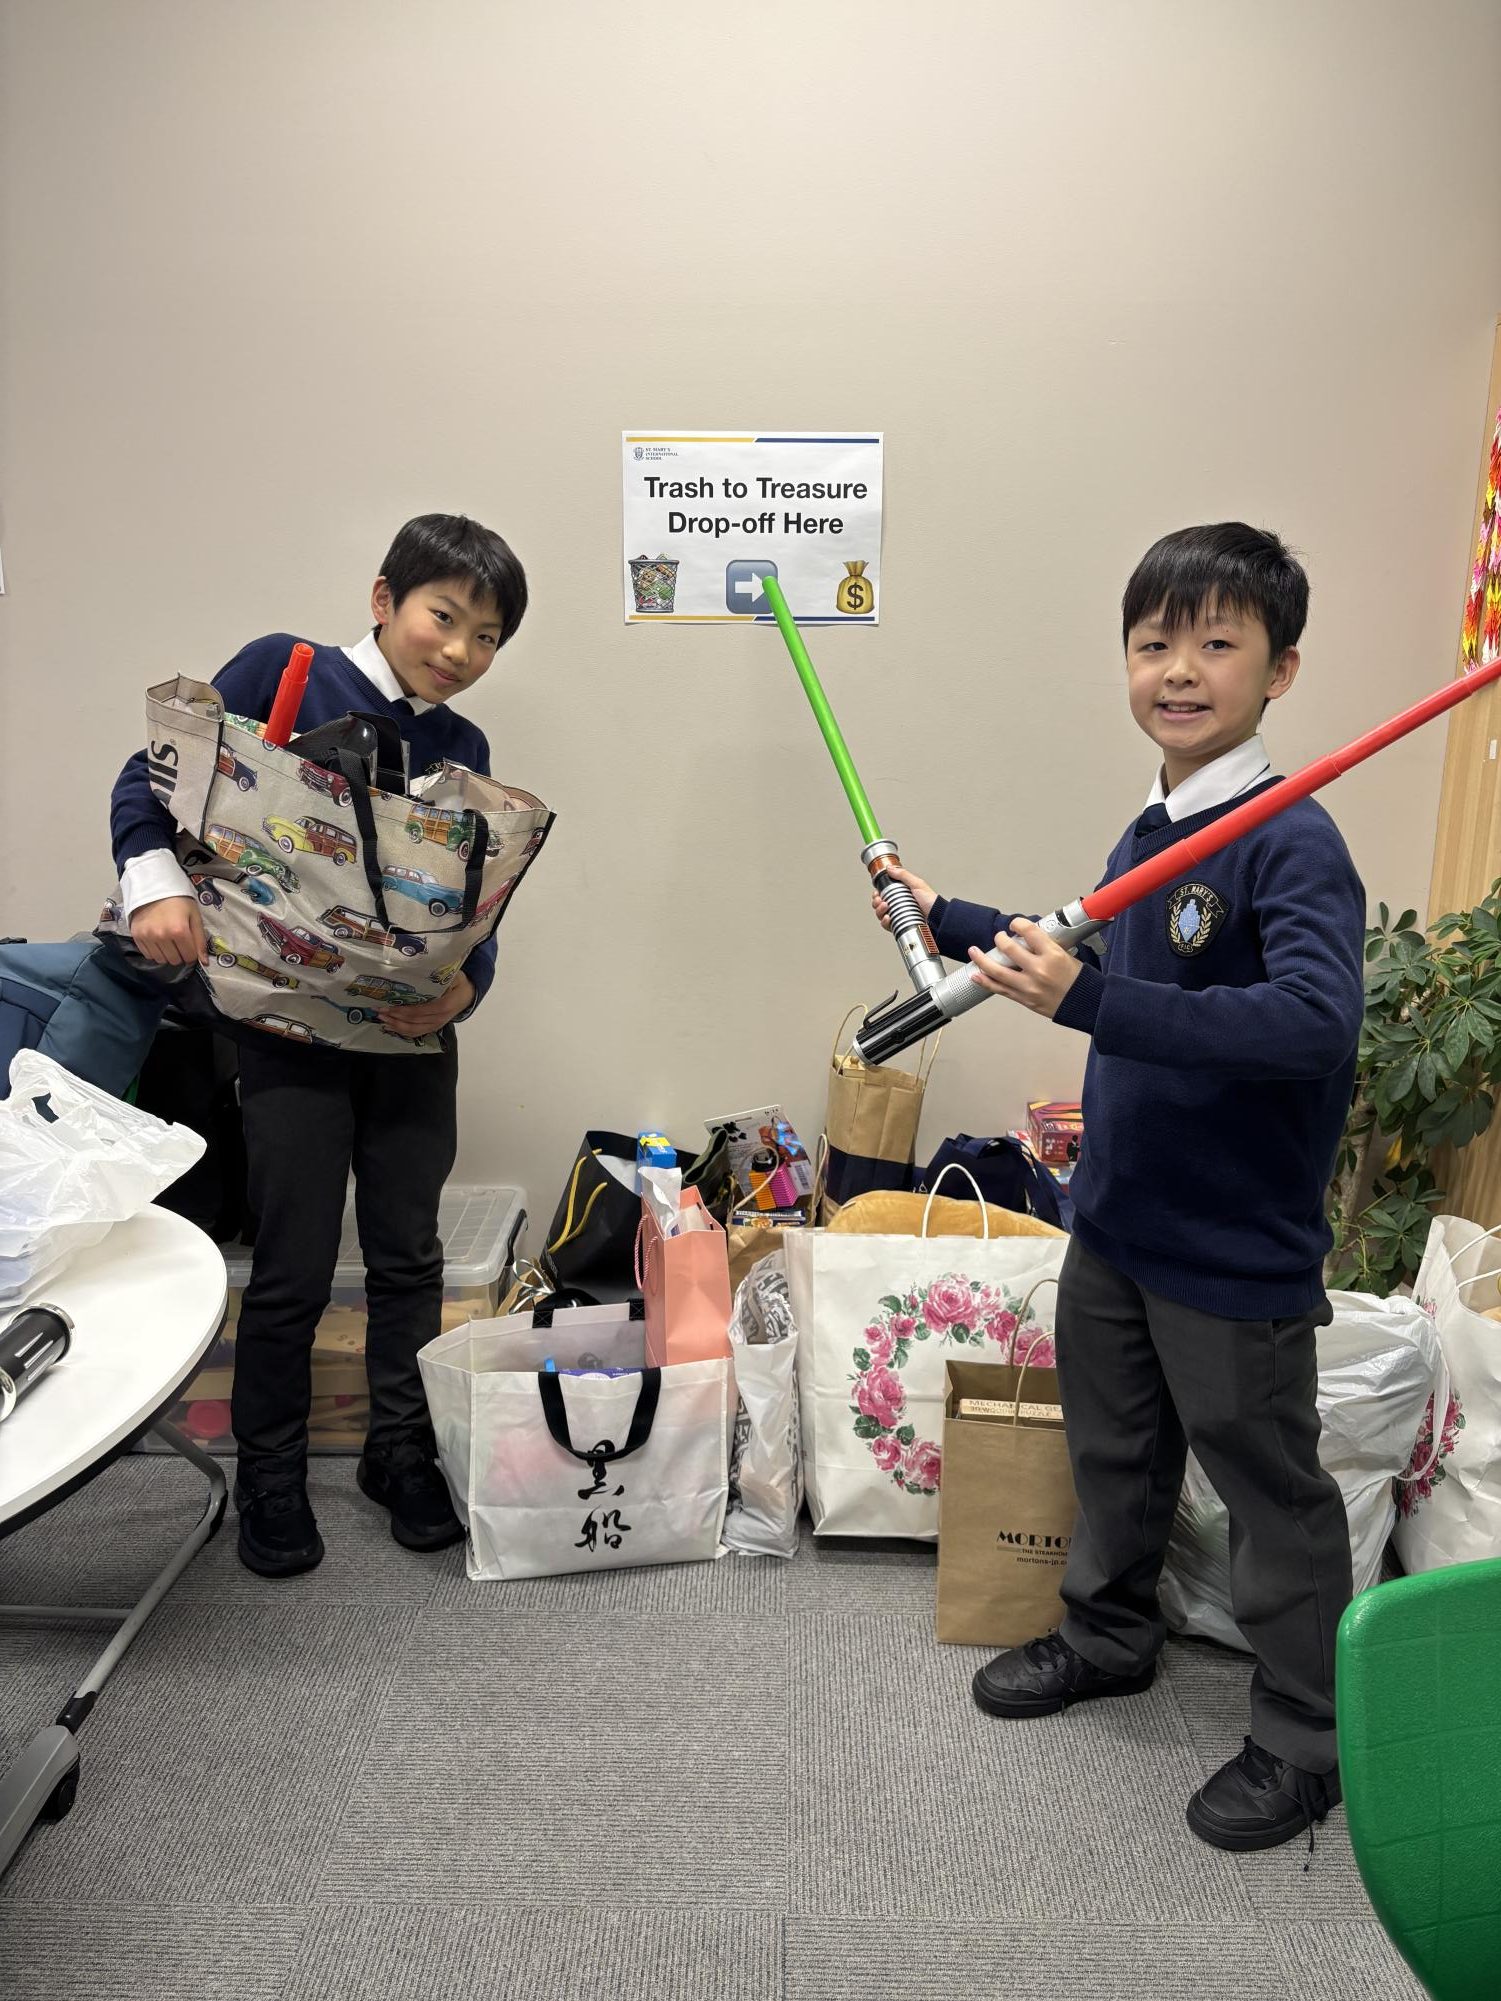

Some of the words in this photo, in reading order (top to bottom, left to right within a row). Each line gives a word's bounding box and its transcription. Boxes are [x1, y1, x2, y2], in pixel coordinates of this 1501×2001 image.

[643, 476, 714, 499] Trash
[722, 478, 748, 499] to
[756, 477, 868, 499] Treasure
[668, 511, 776, 538] Drop-off
[784, 512, 844, 534] Here
[1191, 885, 1214, 902] MARY'S
[997, 1530, 1071, 1550] MORTO
